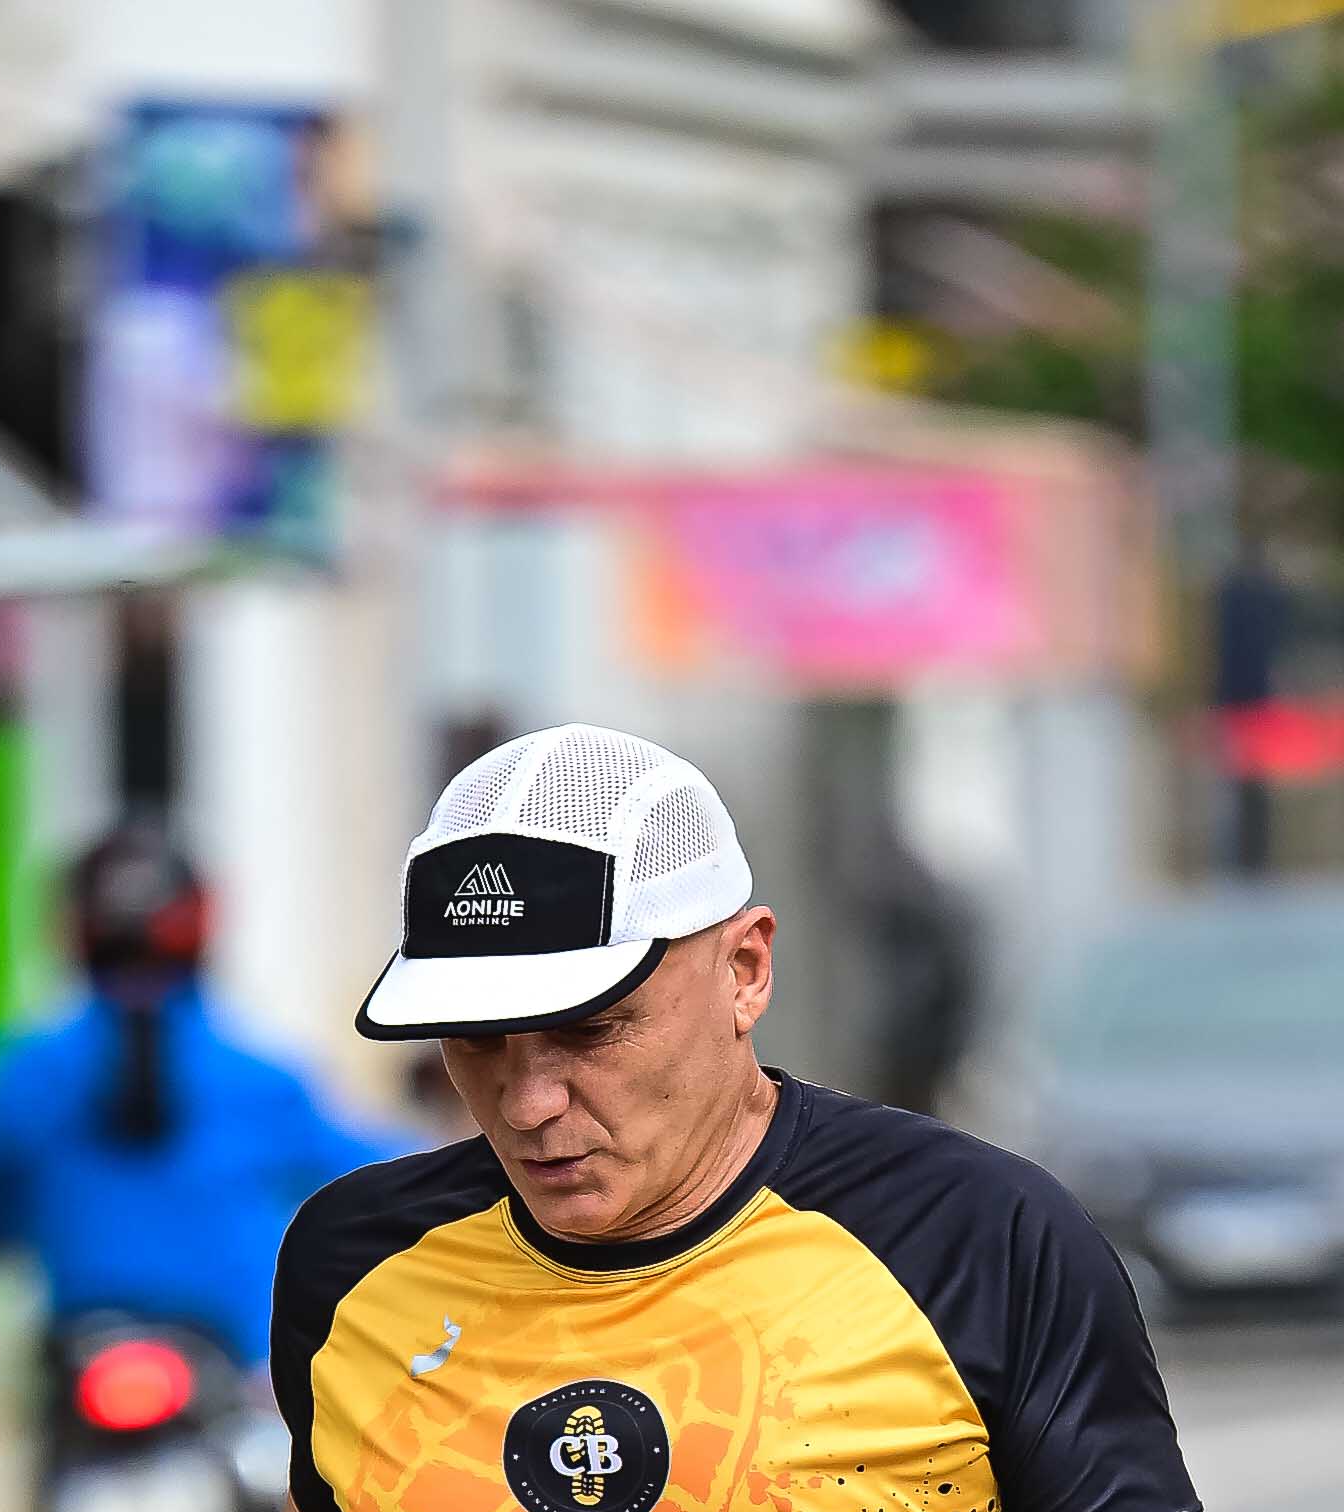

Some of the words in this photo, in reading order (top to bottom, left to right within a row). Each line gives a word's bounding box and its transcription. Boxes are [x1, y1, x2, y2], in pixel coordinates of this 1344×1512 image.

[443, 899, 525, 918] AONIJIE
[452, 917, 511, 926] RUNNING
[549, 1433, 624, 1477] CB
